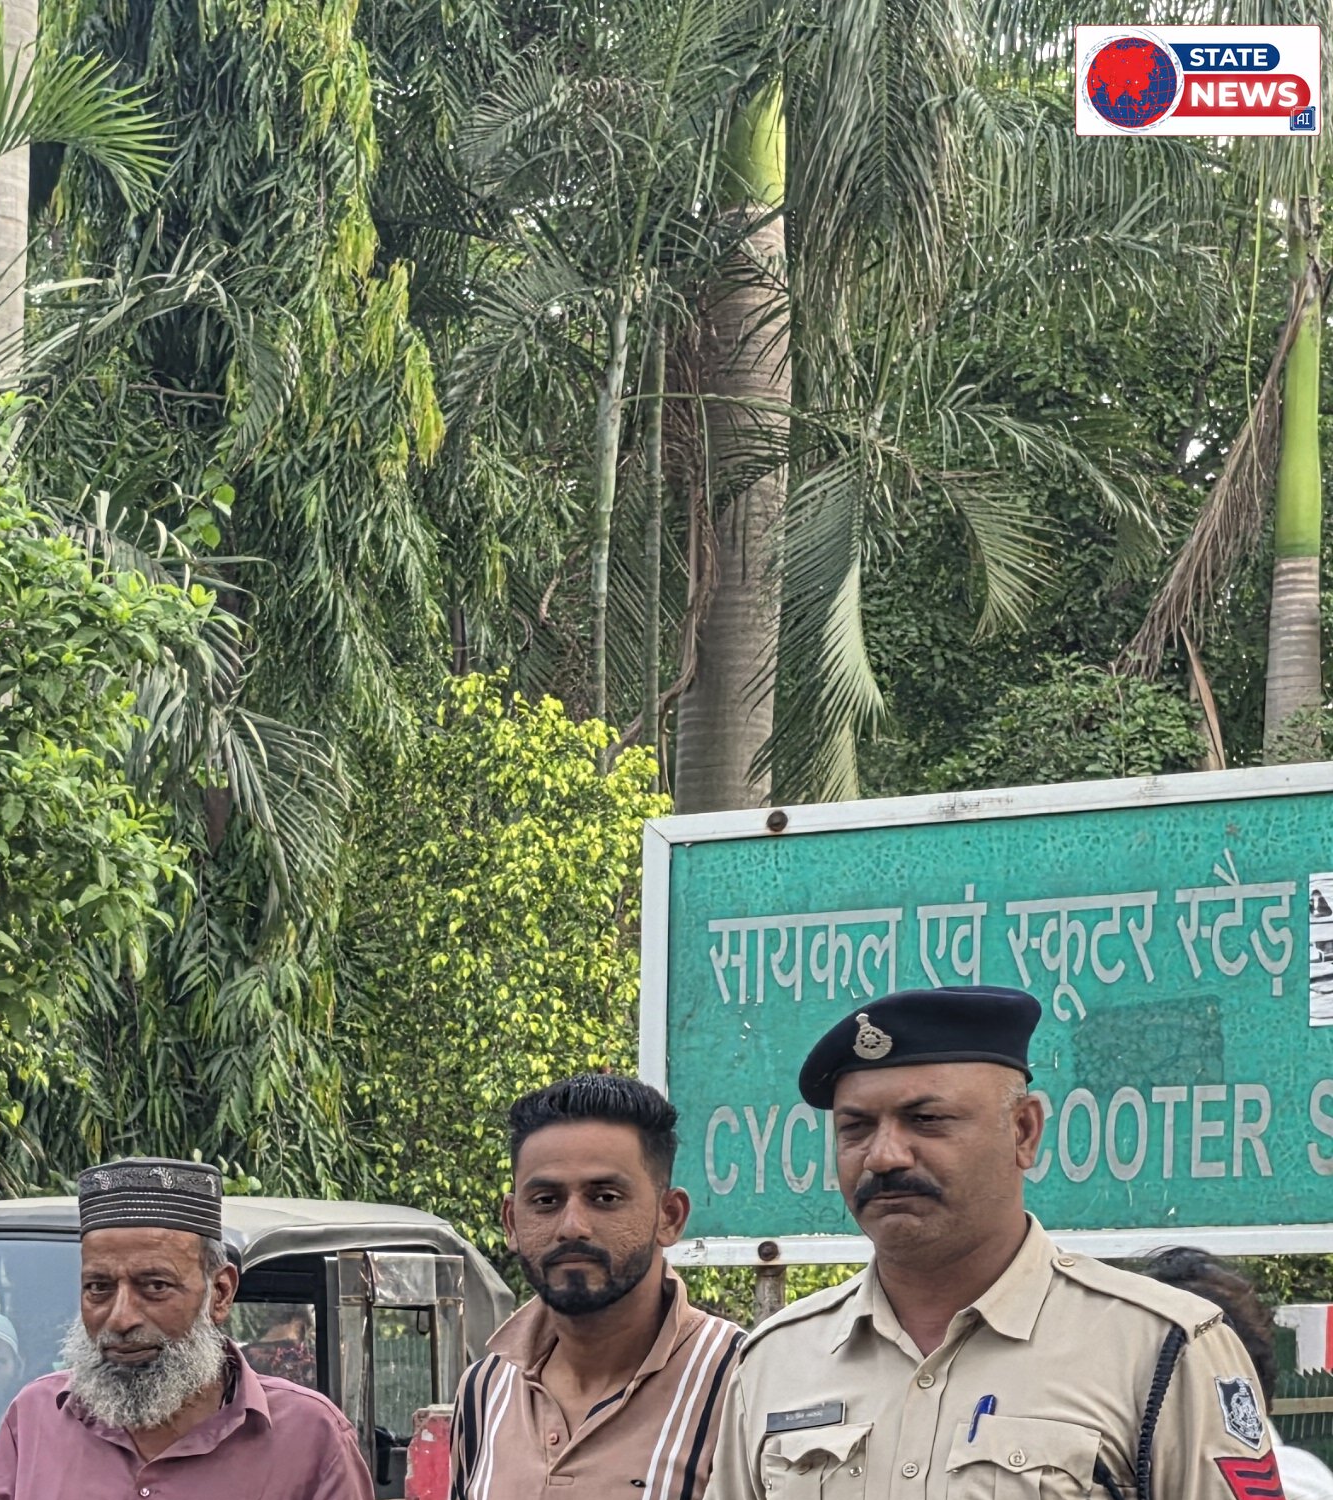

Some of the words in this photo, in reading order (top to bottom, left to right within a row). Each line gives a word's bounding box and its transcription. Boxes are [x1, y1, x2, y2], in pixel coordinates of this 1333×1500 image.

[708, 907, 903, 1004] सायकल
[917, 884, 987, 987] एवं
[1006, 890, 1158, 1021] स्कूटर
[704, 1102, 841, 1195] CYCL
[1023, 1083, 1274, 1184] COOTER
